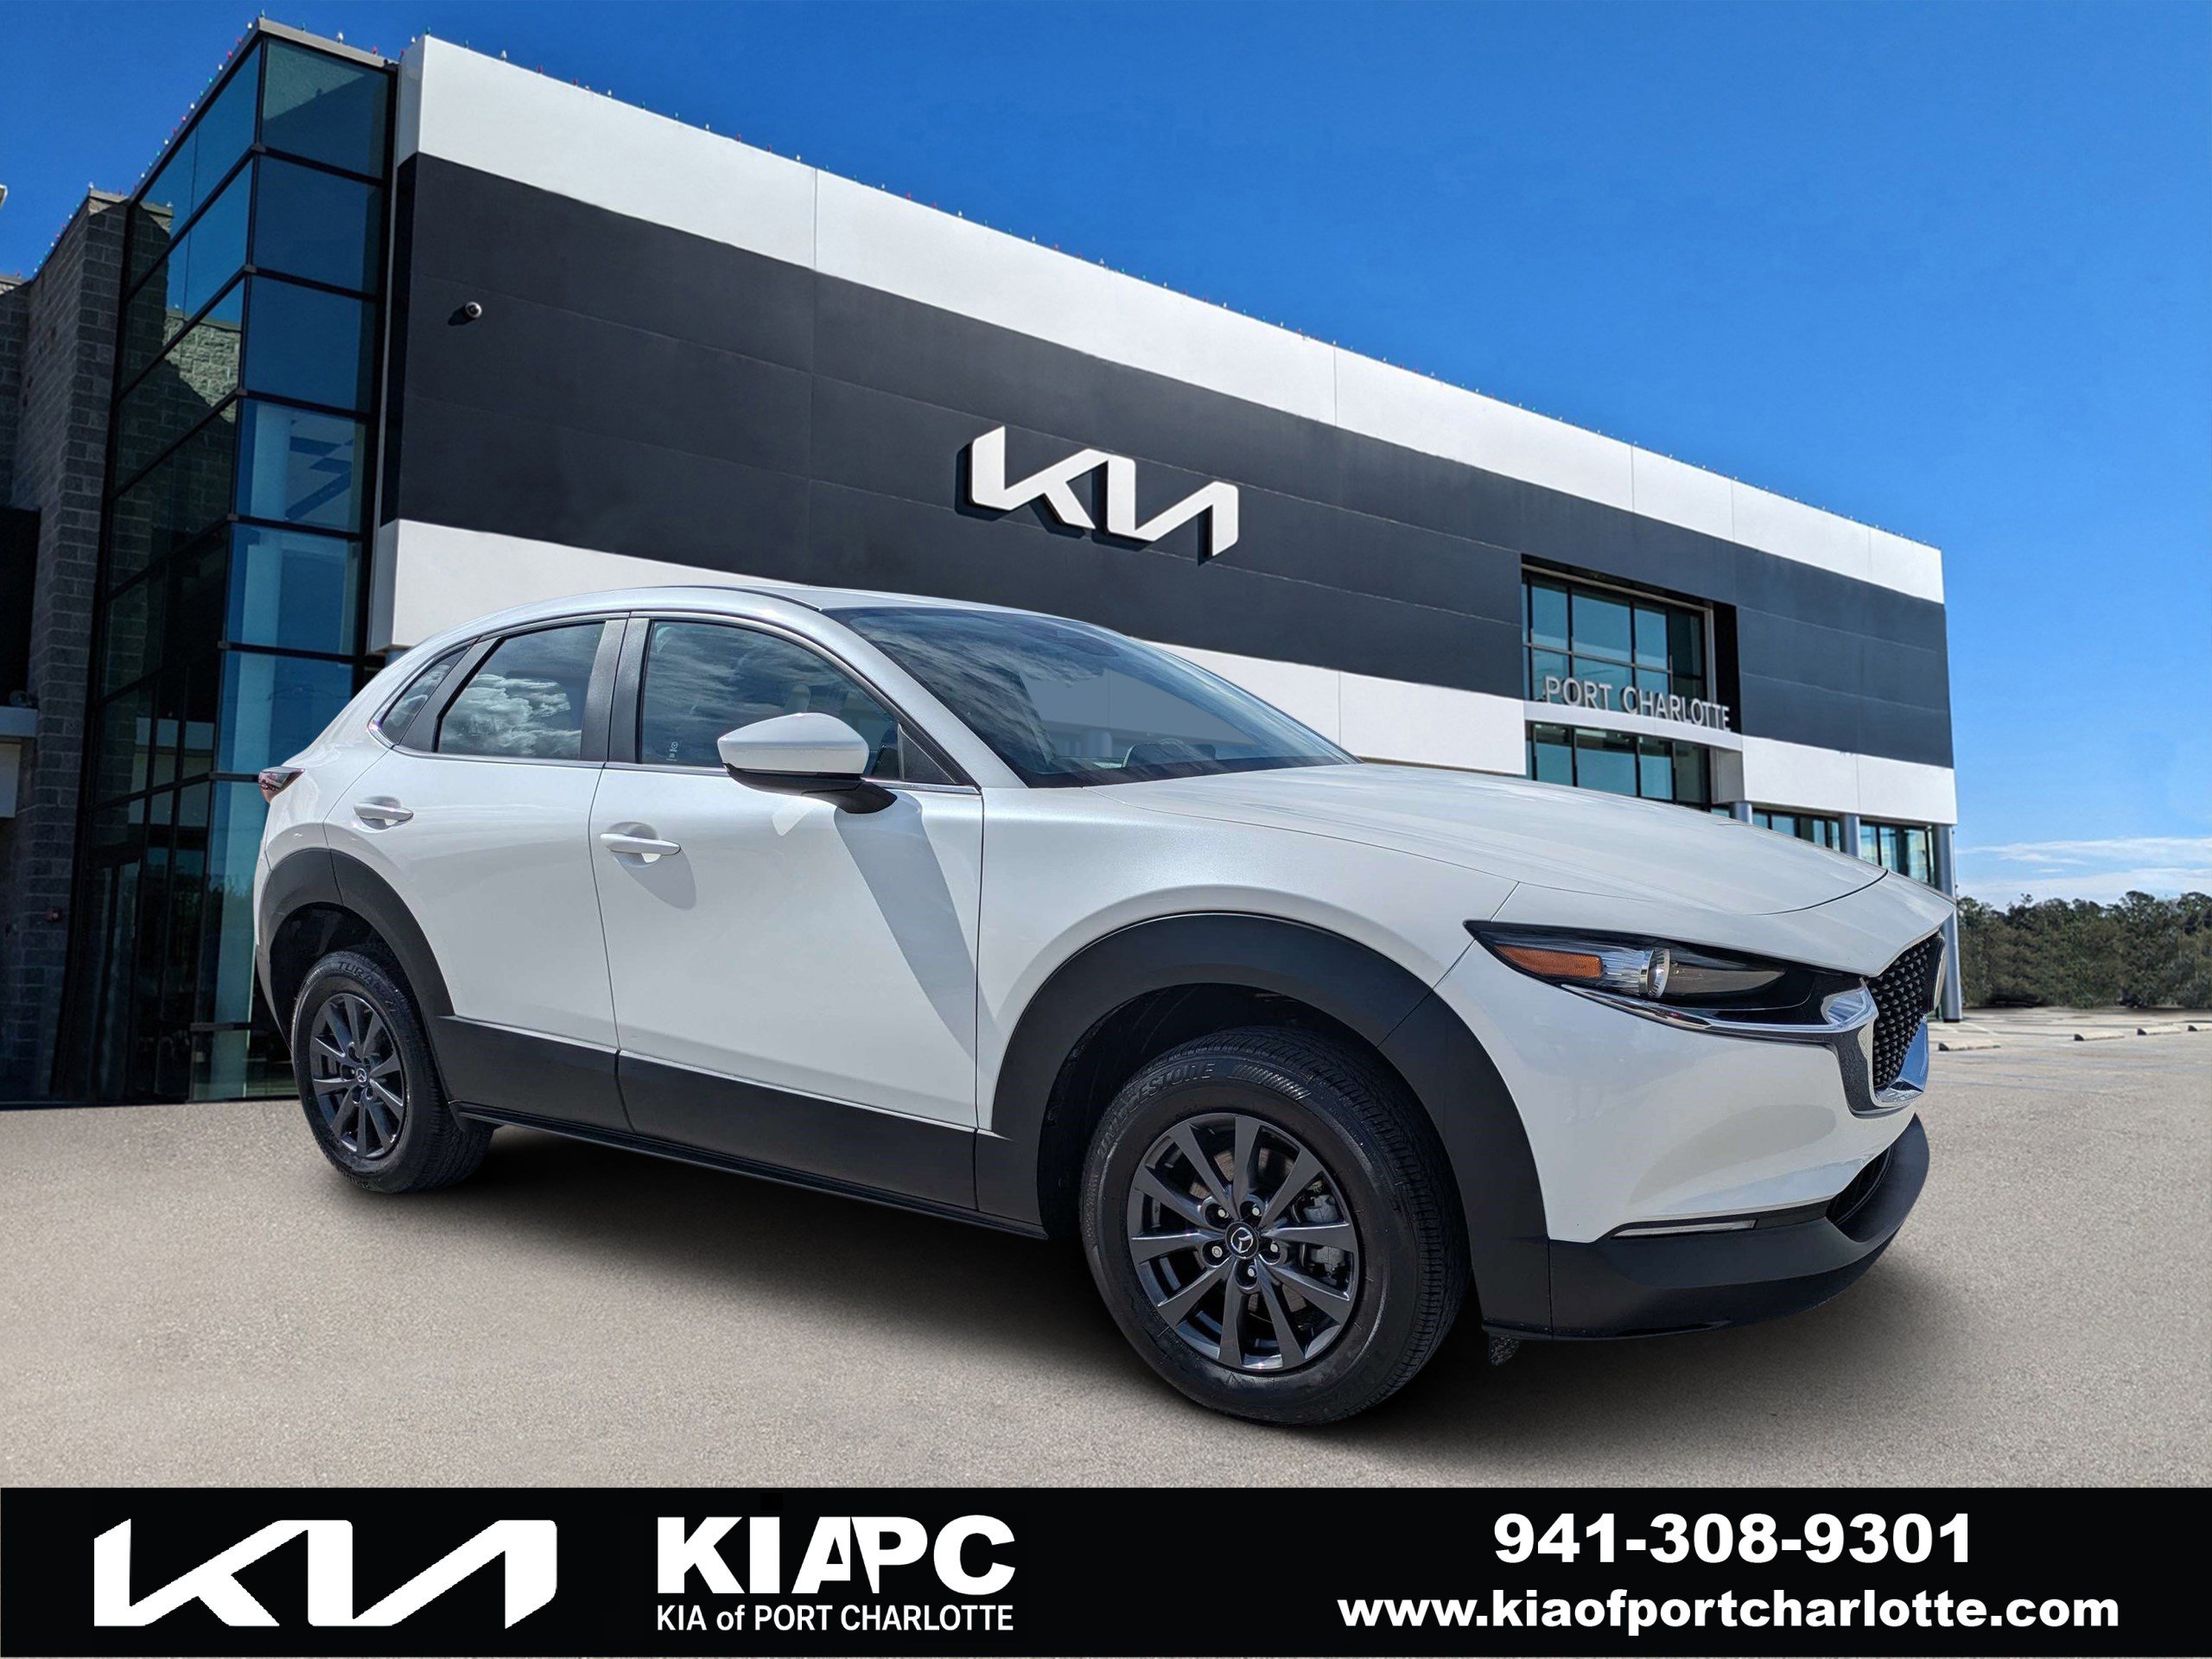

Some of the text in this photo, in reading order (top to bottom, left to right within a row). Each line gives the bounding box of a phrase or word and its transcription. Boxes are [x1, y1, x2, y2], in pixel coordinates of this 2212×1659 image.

[971, 426, 1239, 556] KIA
[1545, 676, 1731, 731] PORT CHARLOTTE
